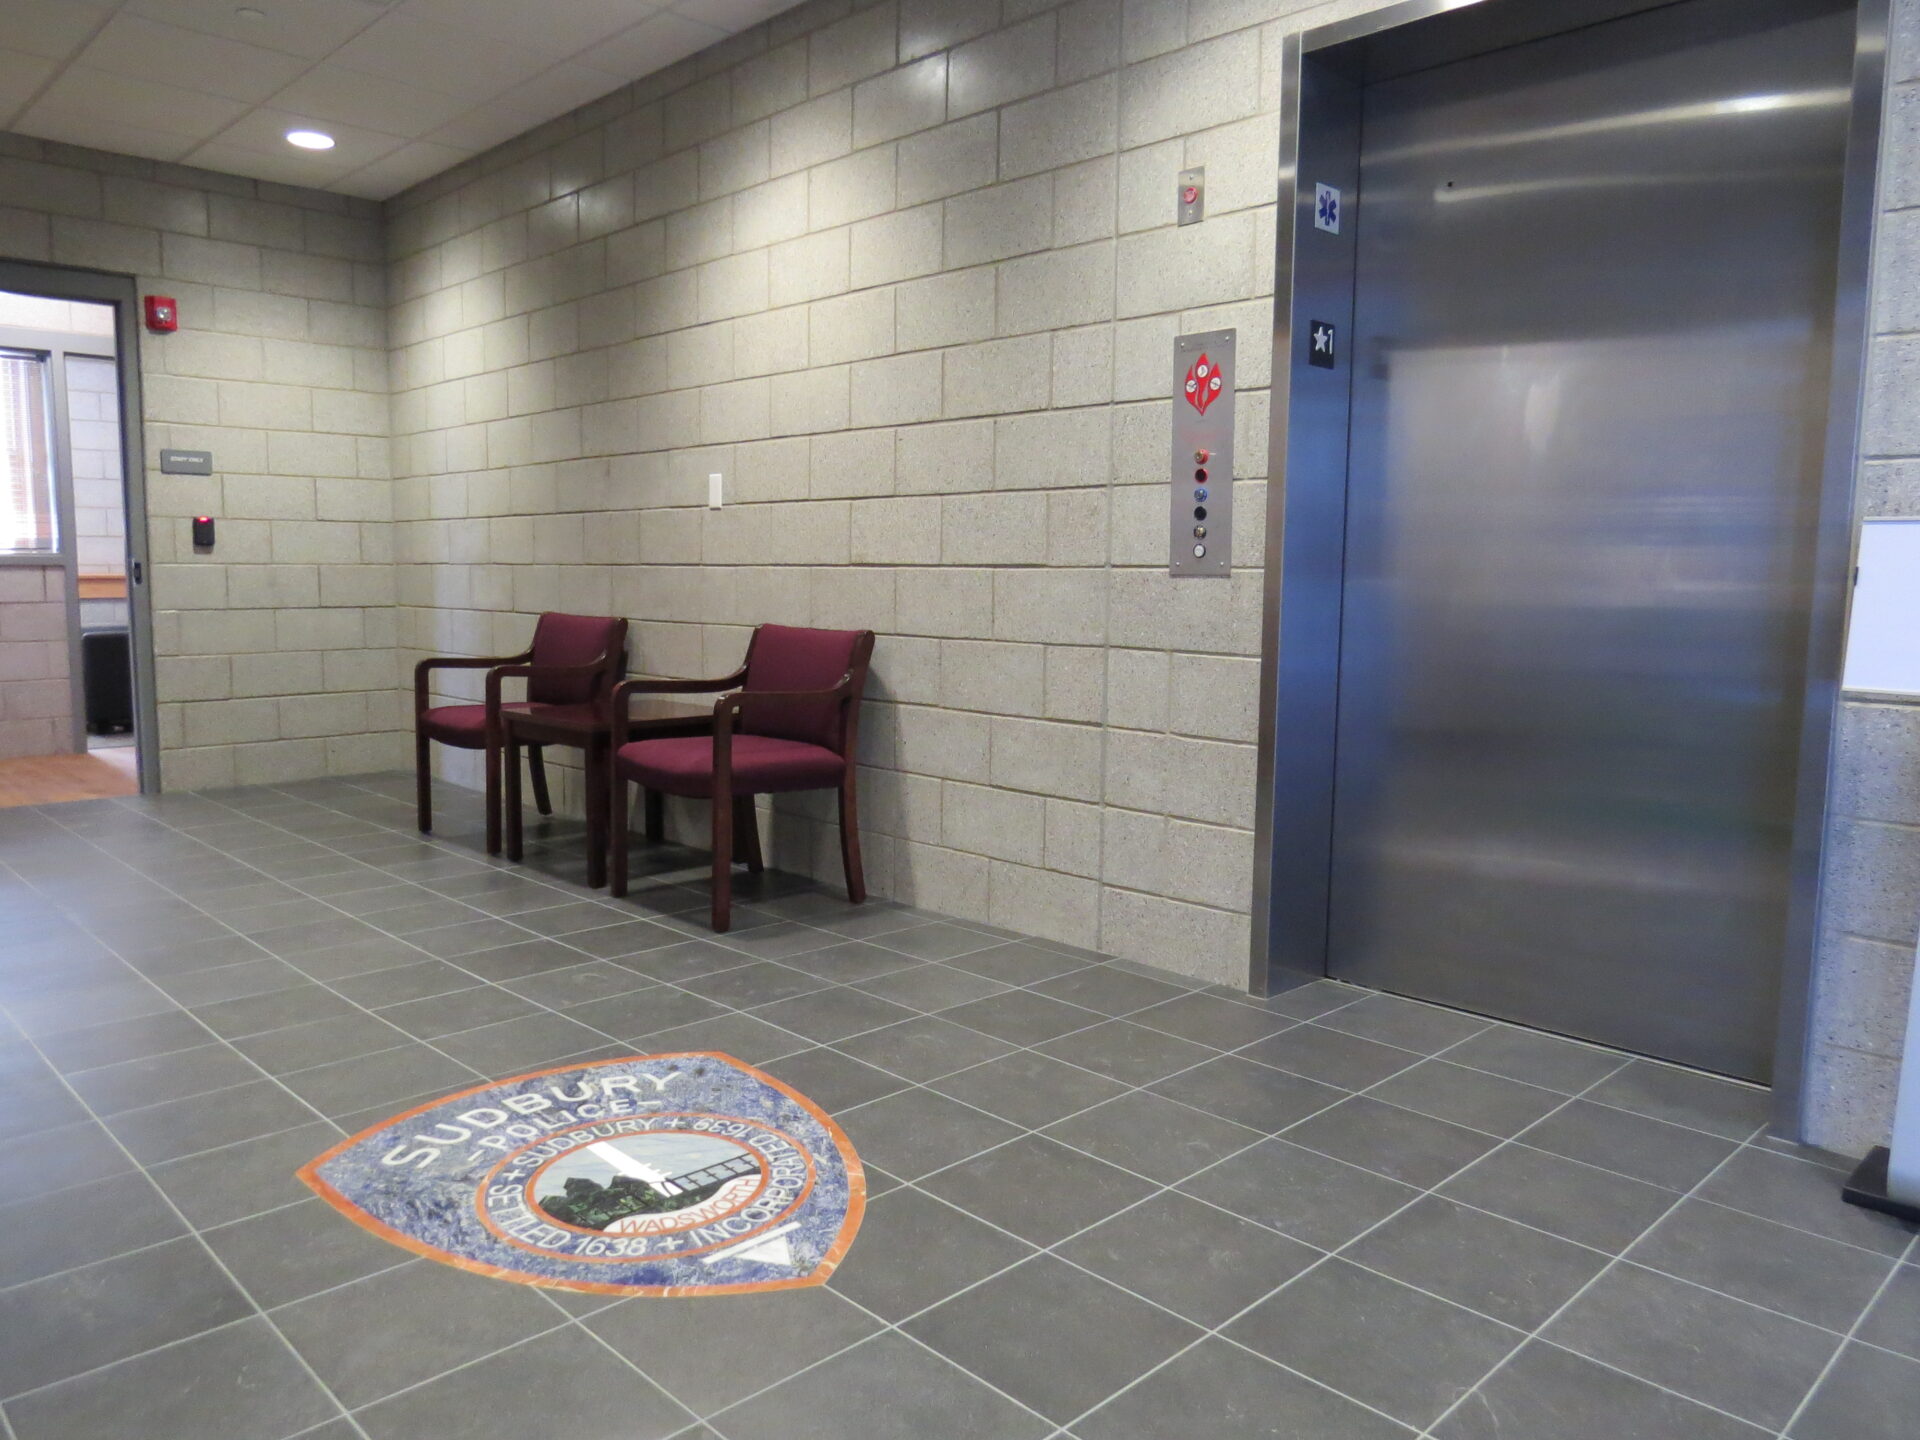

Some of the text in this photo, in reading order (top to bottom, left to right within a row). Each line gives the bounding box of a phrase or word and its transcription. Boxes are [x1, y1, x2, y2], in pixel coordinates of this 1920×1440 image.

[1327, 329, 1334, 355] 1
[381, 1071, 683, 1169] SUDBURY
[512, 1118, 657, 1168] SUDBURY
[619, 1178, 761, 1233] WADSWORTH
[689, 1117, 805, 1246] INCORPORATED 1639
[488, 1184, 649, 1256] SETTLED 1638
